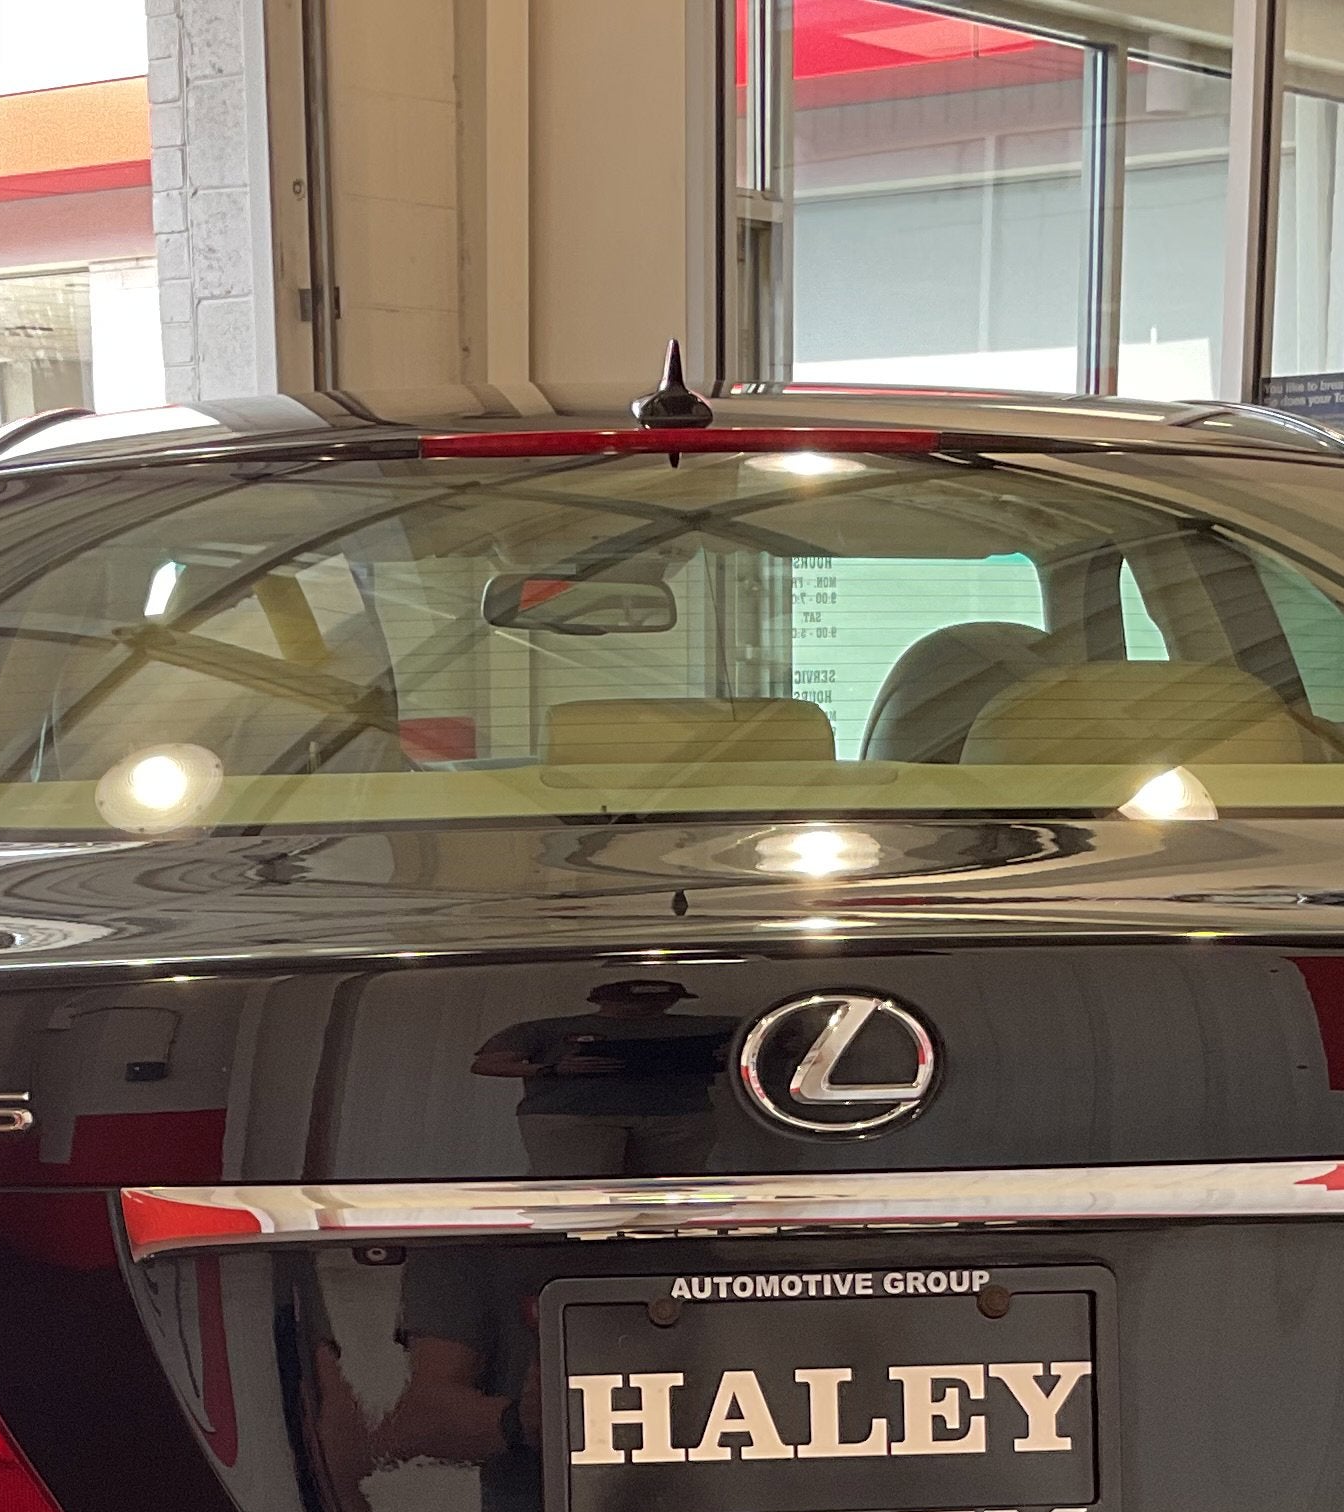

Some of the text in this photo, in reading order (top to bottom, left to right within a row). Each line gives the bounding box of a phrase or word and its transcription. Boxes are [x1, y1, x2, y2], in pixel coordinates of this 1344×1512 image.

[1307, 382, 1318, 392] to
[1308, 394, 1332, 407] your
[670, 1269, 991, 1300] AUTOMOTIVE GROUP
[567, 1360, 1093, 1465] HALEY
